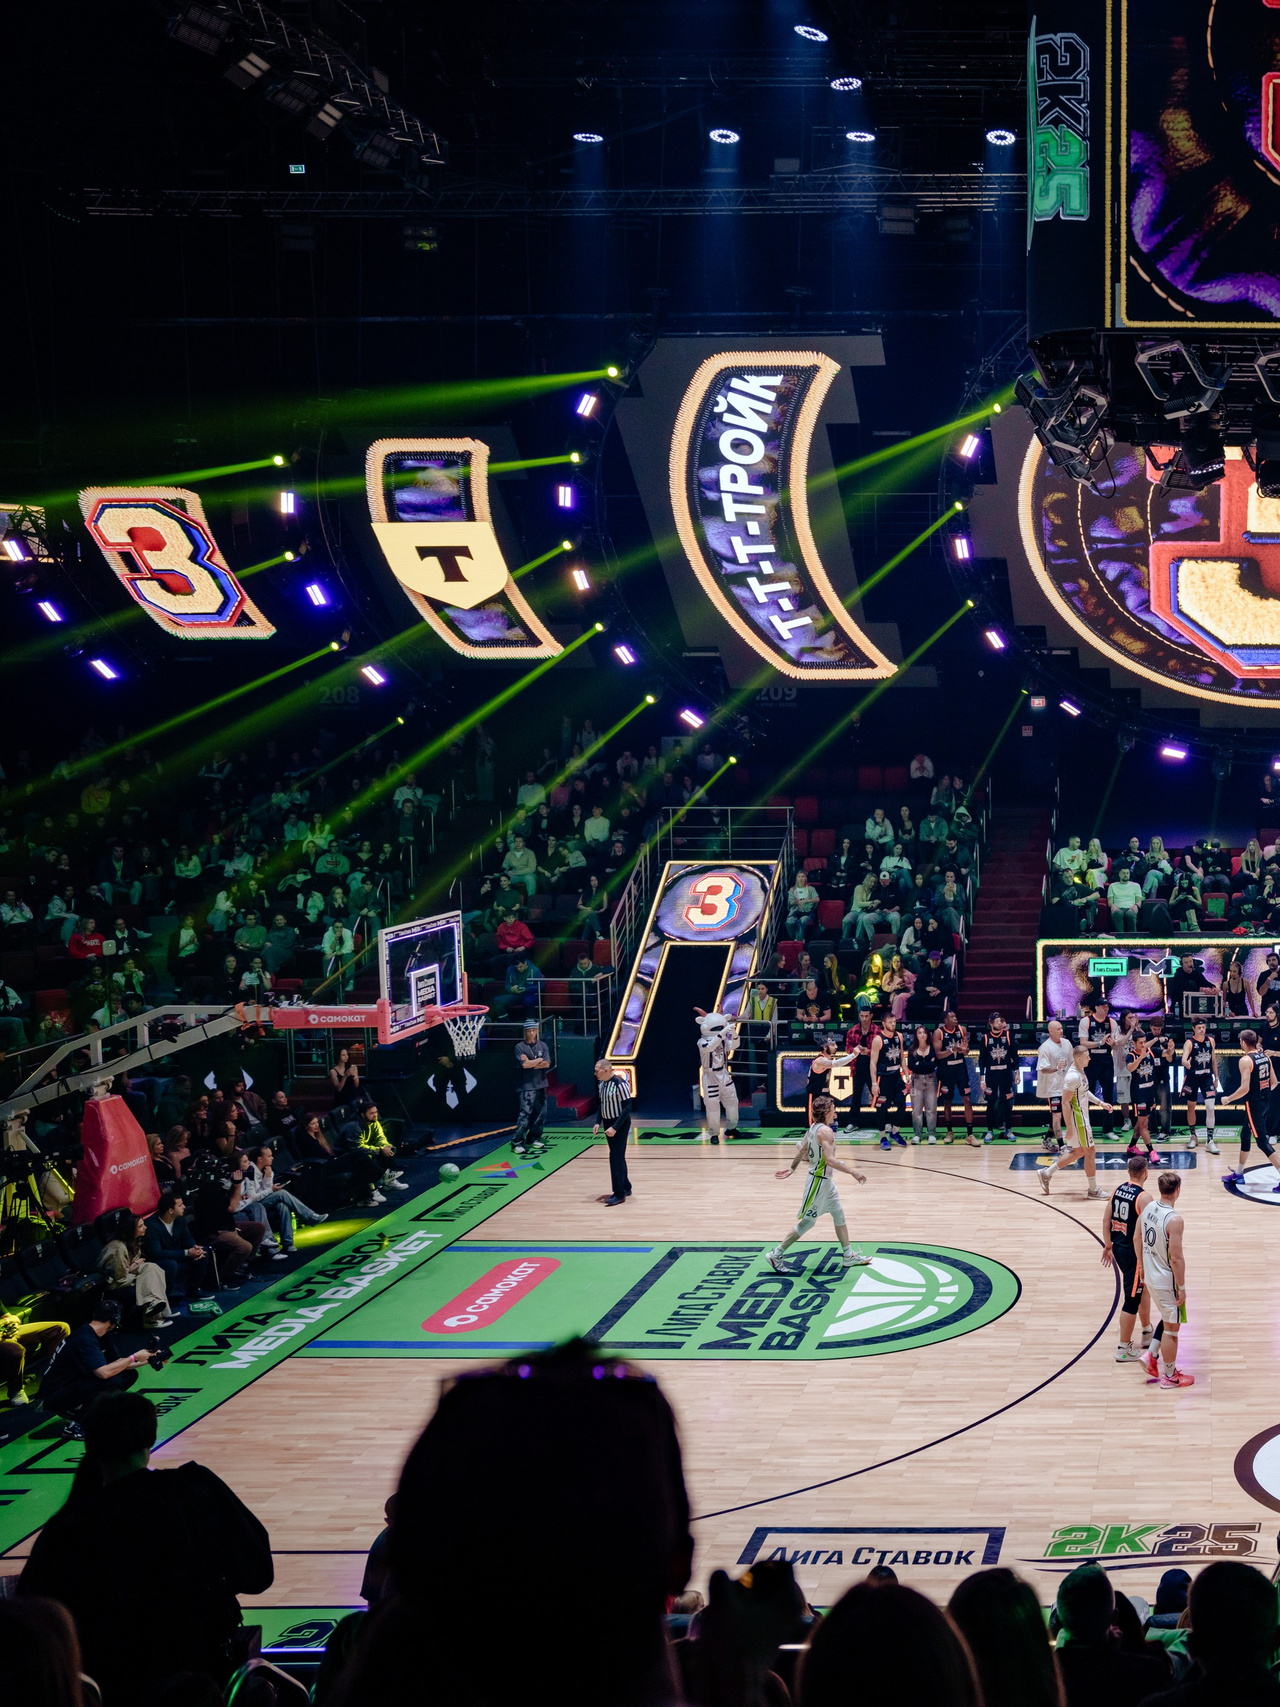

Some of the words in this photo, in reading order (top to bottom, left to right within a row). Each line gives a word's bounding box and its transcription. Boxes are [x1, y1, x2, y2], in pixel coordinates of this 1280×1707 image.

[1033, 32, 1091, 222] 2K25
[86, 499, 246, 626] 3
[682, 873, 745, 931] 3
[806, 1210, 818, 1218] 26
[1113, 1199, 1129, 1220] 10
[1144, 1222, 1156, 1247] 10
[170, 1310, 289, 1366] ЛИГА
[275, 1232, 410, 1302] СТАВОК
[210, 1302, 340, 1369] MEDIA
[318, 1230, 443, 1299] BASKET
[469, 1261, 544, 1314] самокат
[697, 1247, 822, 1350] MEDIA
[1042, 1522, 1262, 1557] 2K25
